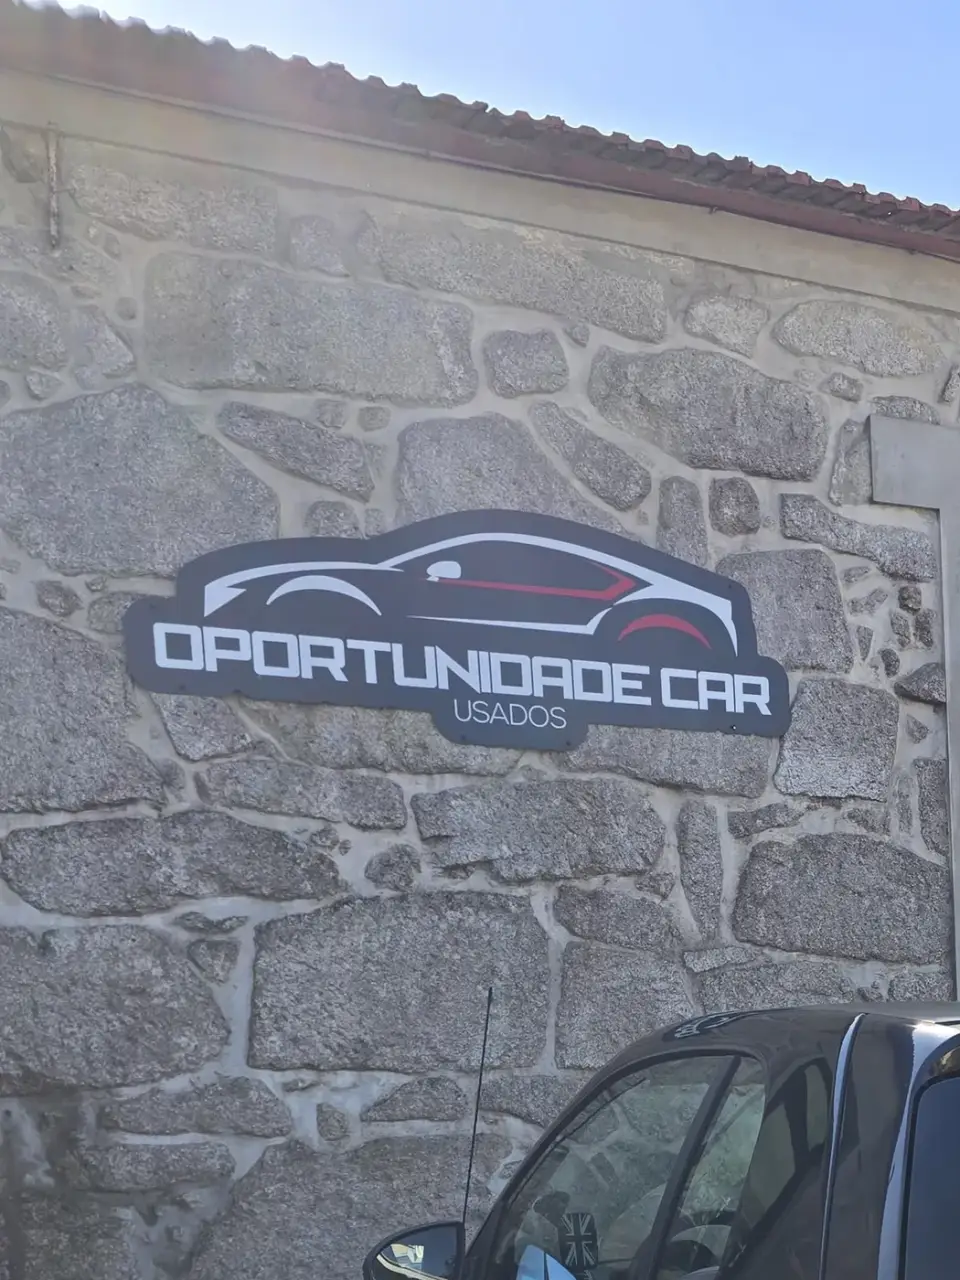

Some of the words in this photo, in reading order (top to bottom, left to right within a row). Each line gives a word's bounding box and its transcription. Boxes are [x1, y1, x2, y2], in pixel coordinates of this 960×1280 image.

[153, 621, 652, 706] OPORTUNIDADE
[661, 668, 772, 715] CAR
[453, 699, 567, 729] USADOS
